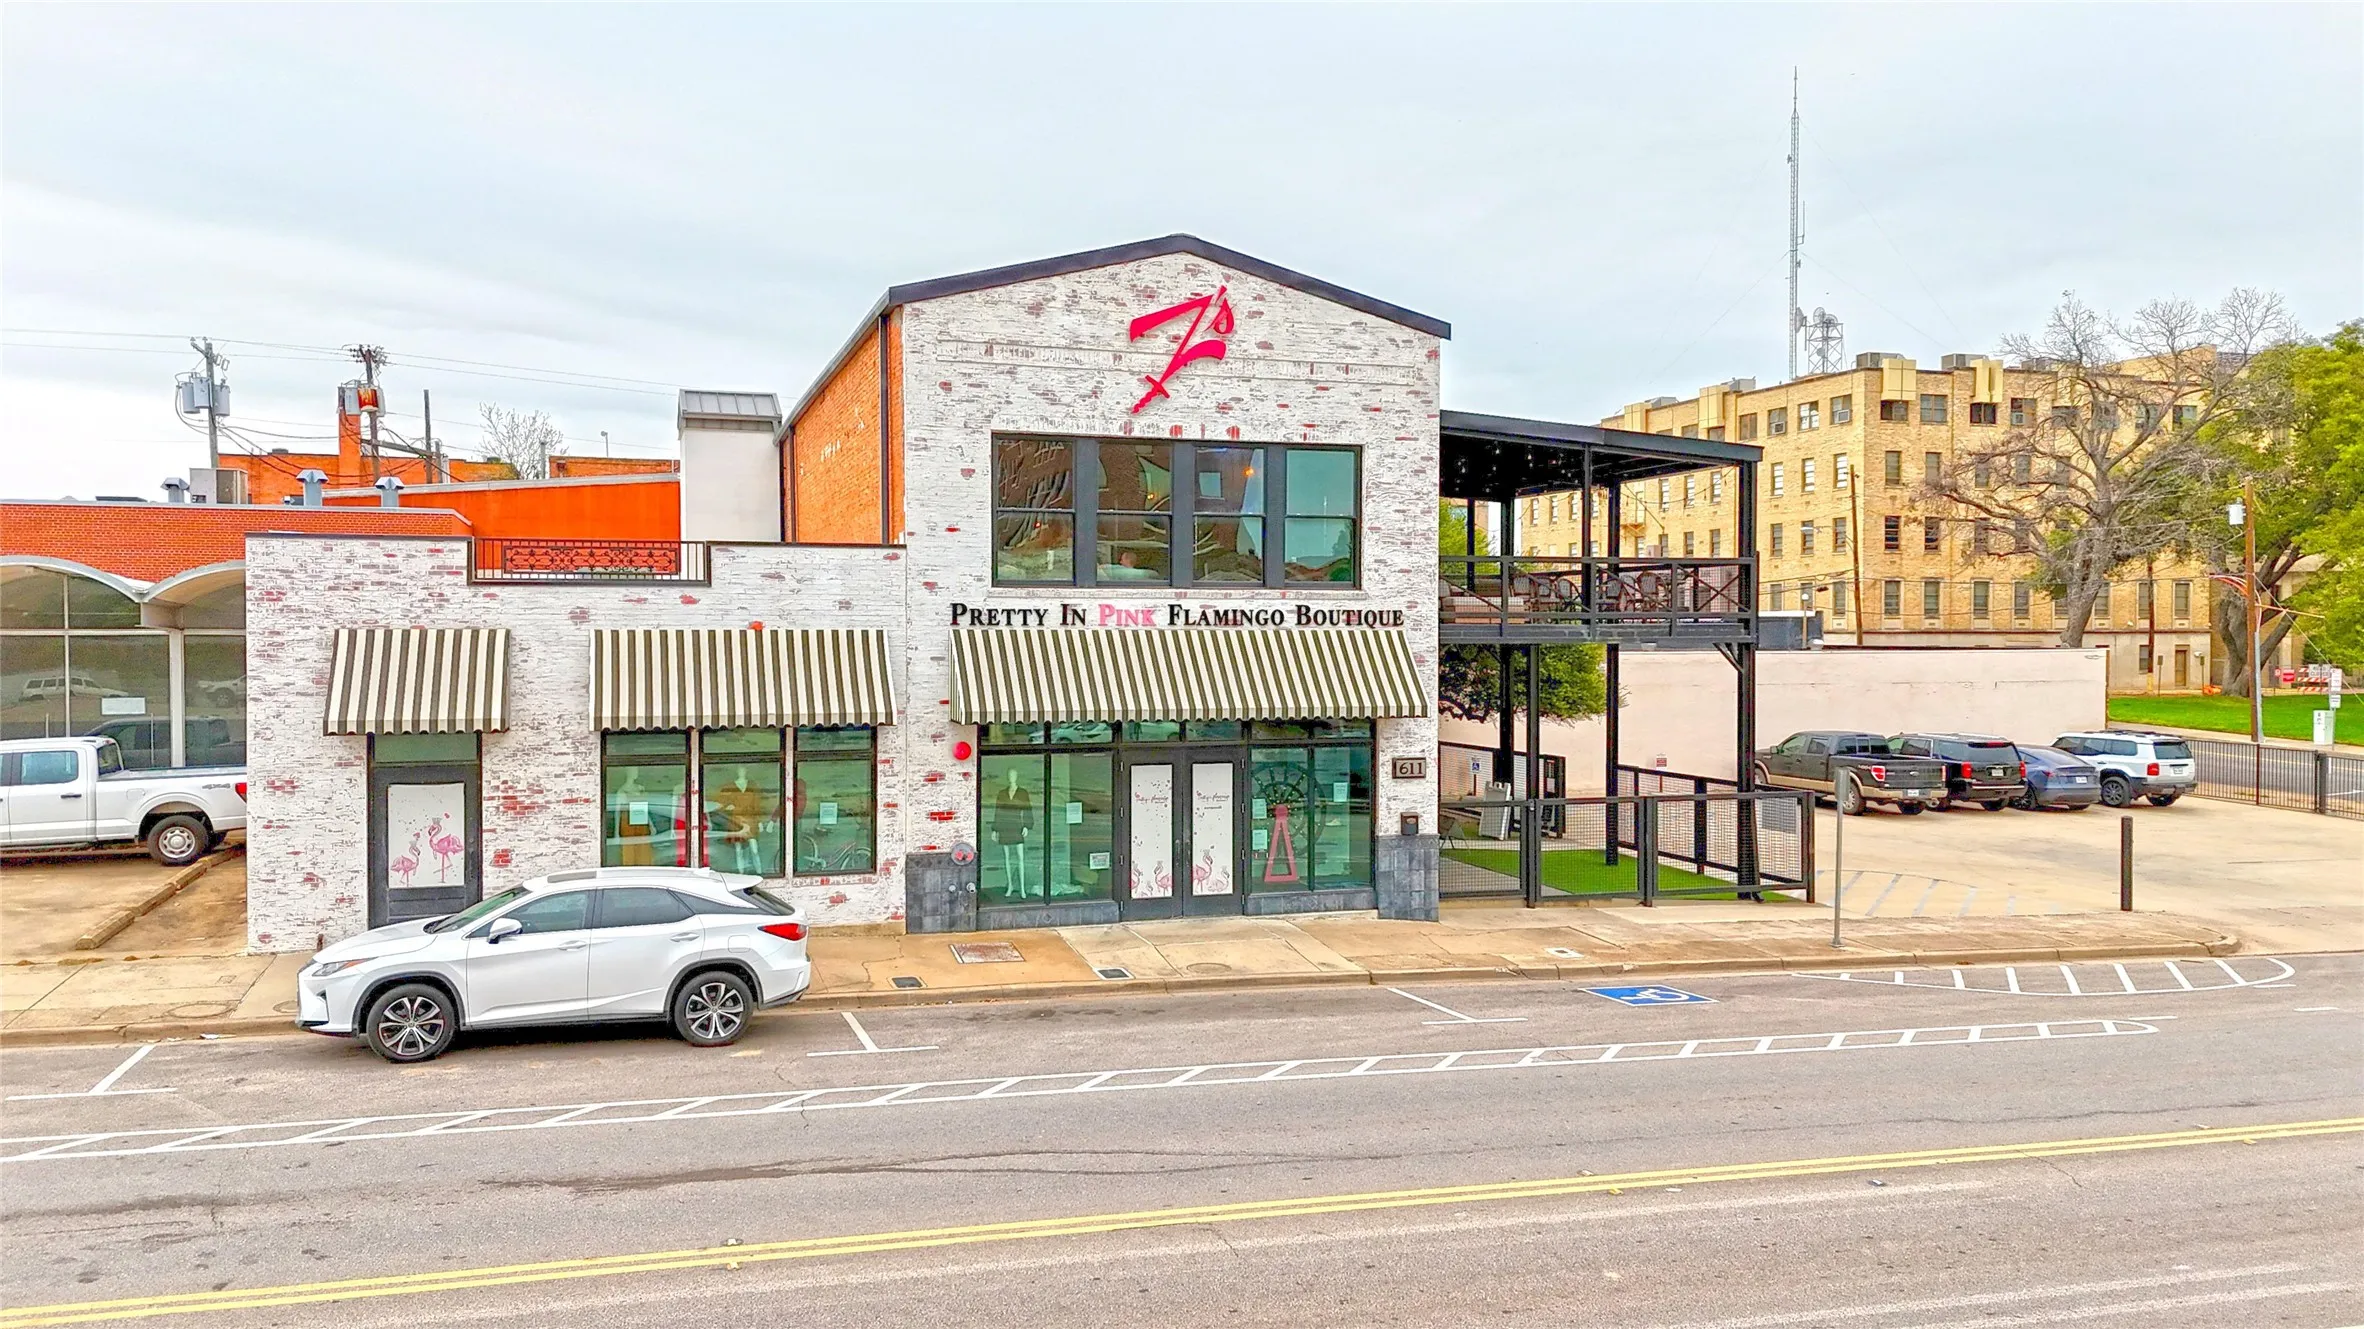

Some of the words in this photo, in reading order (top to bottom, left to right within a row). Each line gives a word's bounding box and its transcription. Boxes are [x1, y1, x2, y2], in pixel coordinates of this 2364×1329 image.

[950, 602, 1048, 626] PRETTY
[1060, 603, 1087, 626] IN
[1098, 603, 1157, 626] PINK
[1168, 604, 1285, 626] FLAMINGO
[1295, 604, 1404, 629] BOUTIQUE
[1399, 762, 1422, 775] 611
